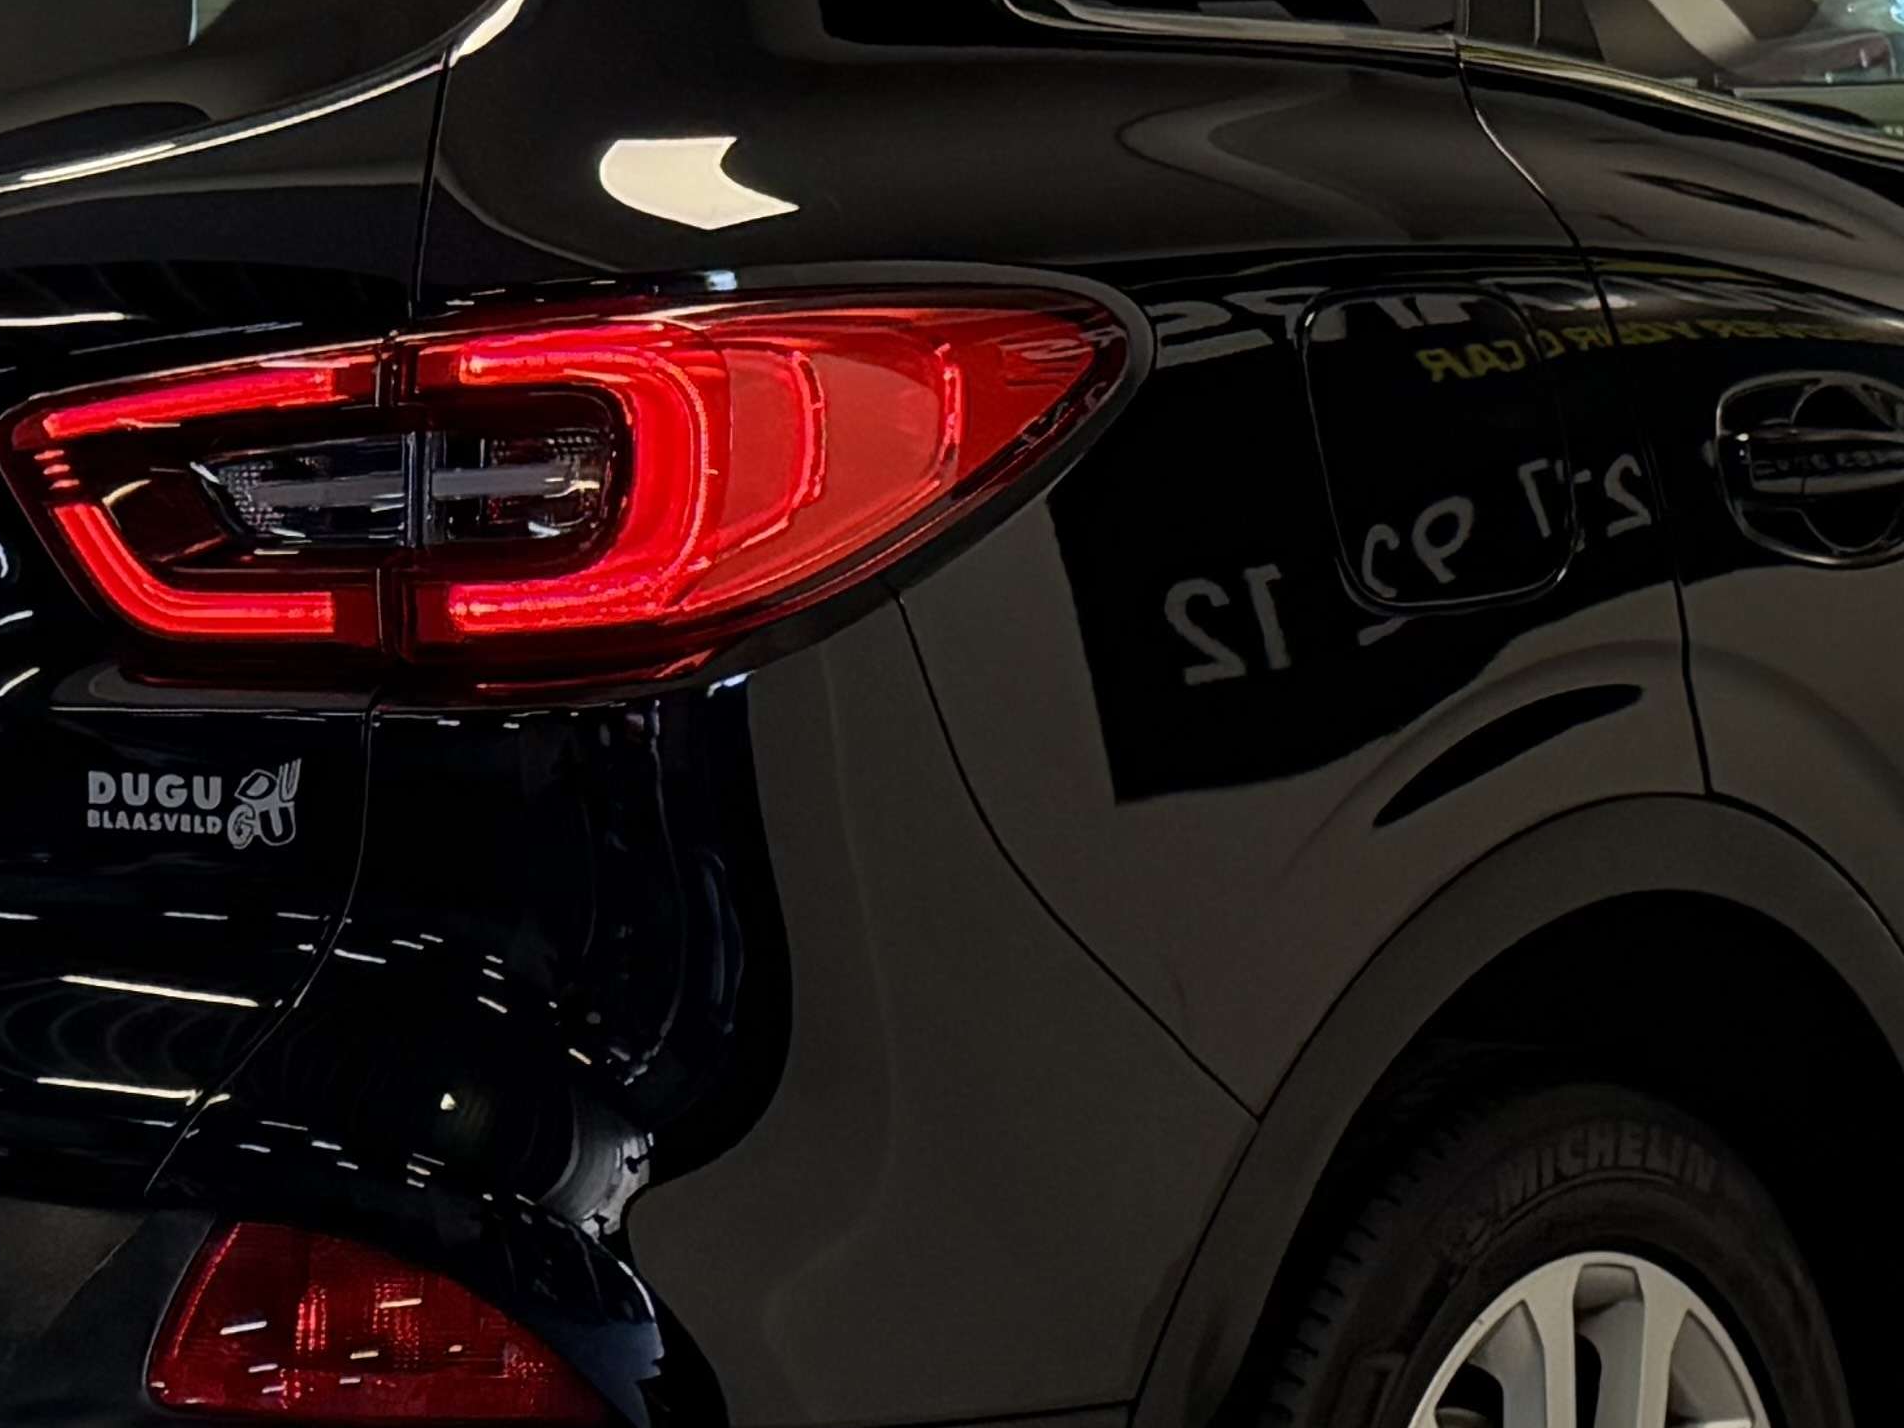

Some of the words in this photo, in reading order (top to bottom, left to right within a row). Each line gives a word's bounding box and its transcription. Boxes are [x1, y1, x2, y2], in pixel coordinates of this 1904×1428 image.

[88, 770, 223, 810] DUGU
[87, 809, 223, 835] BLAASVELD
[1494, 1120, 1716, 1220] MICHELIN
